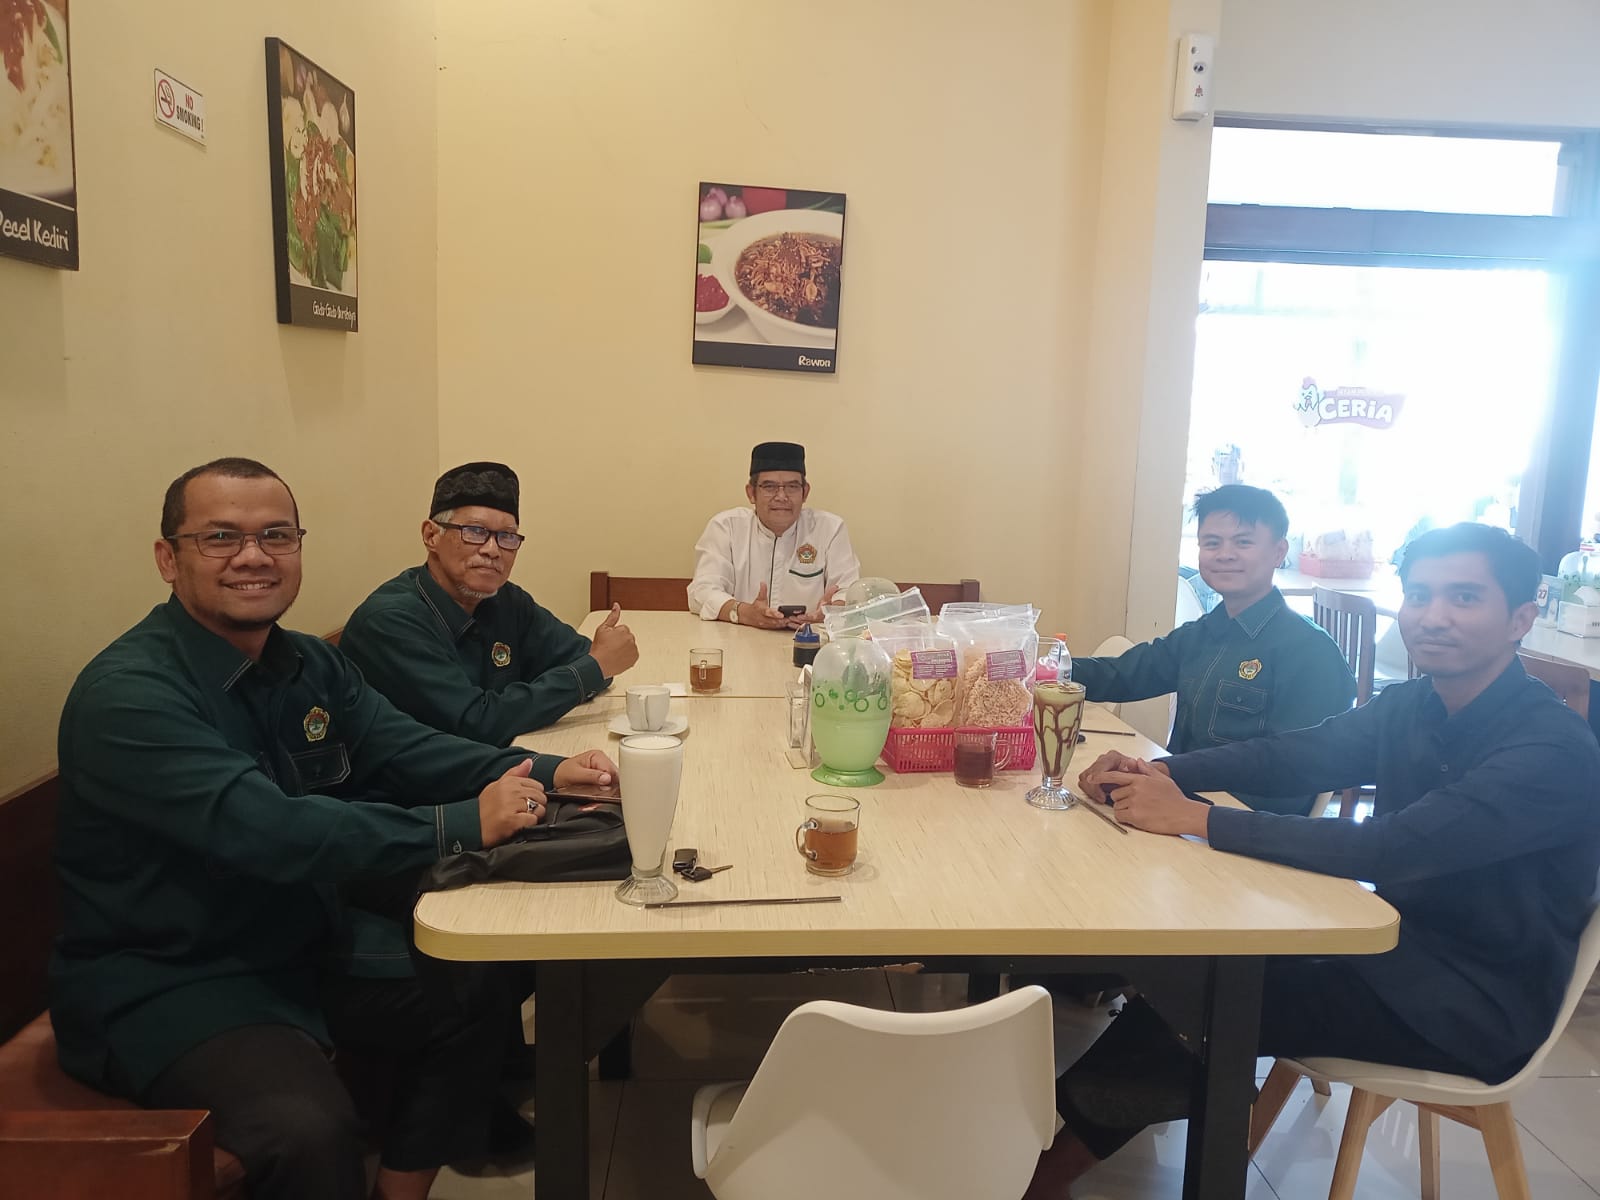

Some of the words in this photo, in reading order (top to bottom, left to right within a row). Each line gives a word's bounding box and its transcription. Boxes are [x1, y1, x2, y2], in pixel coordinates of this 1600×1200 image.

[185, 93, 194, 111] NO
[33, 219, 70, 252] Kediri
[798, 355, 831, 368] Rawon
